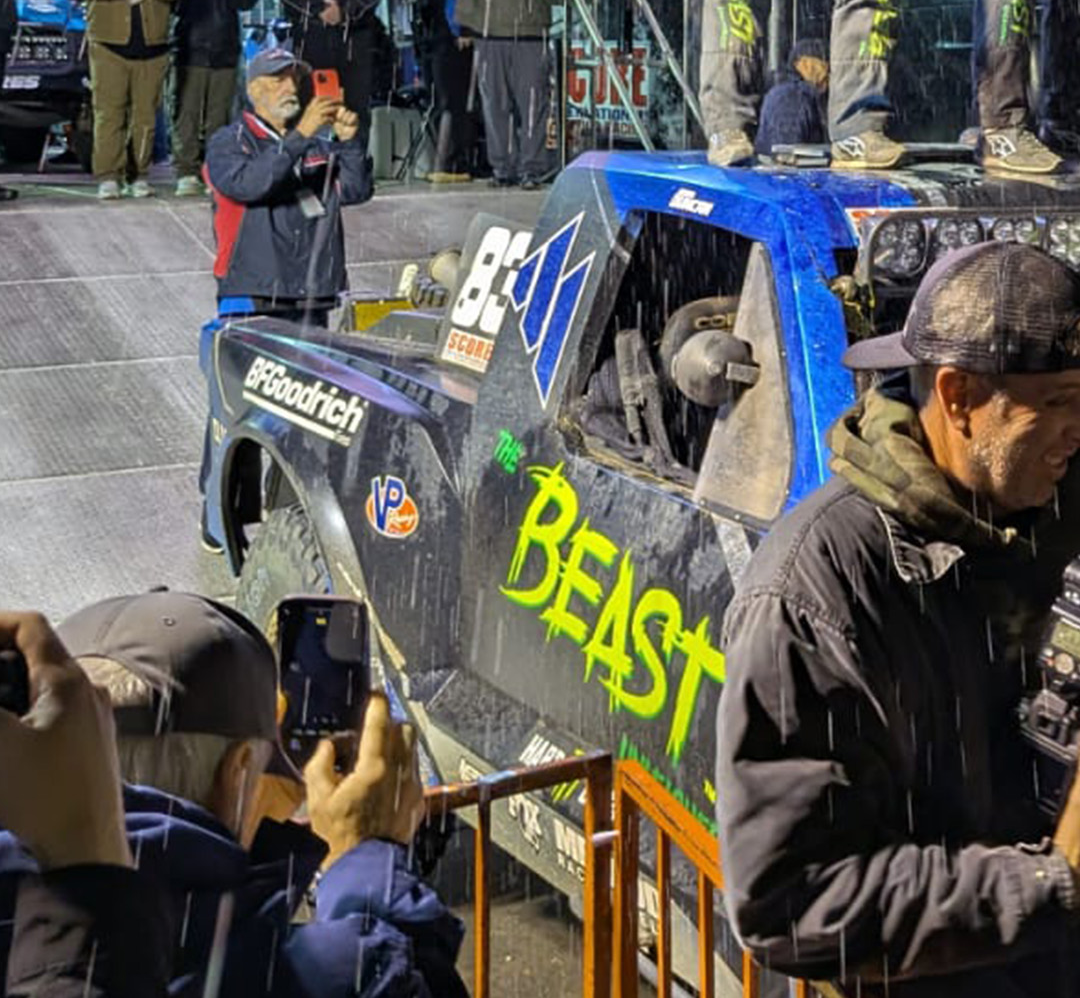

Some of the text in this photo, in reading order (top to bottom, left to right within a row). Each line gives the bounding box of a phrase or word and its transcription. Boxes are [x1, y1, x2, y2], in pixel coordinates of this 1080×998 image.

[448, 332, 496, 361] SCORE
[244, 356, 365, 434] BFGoodrich
[494, 429, 527, 474] THE
[374, 477, 404, 531] VP
[499, 461, 727, 767] BEAST
